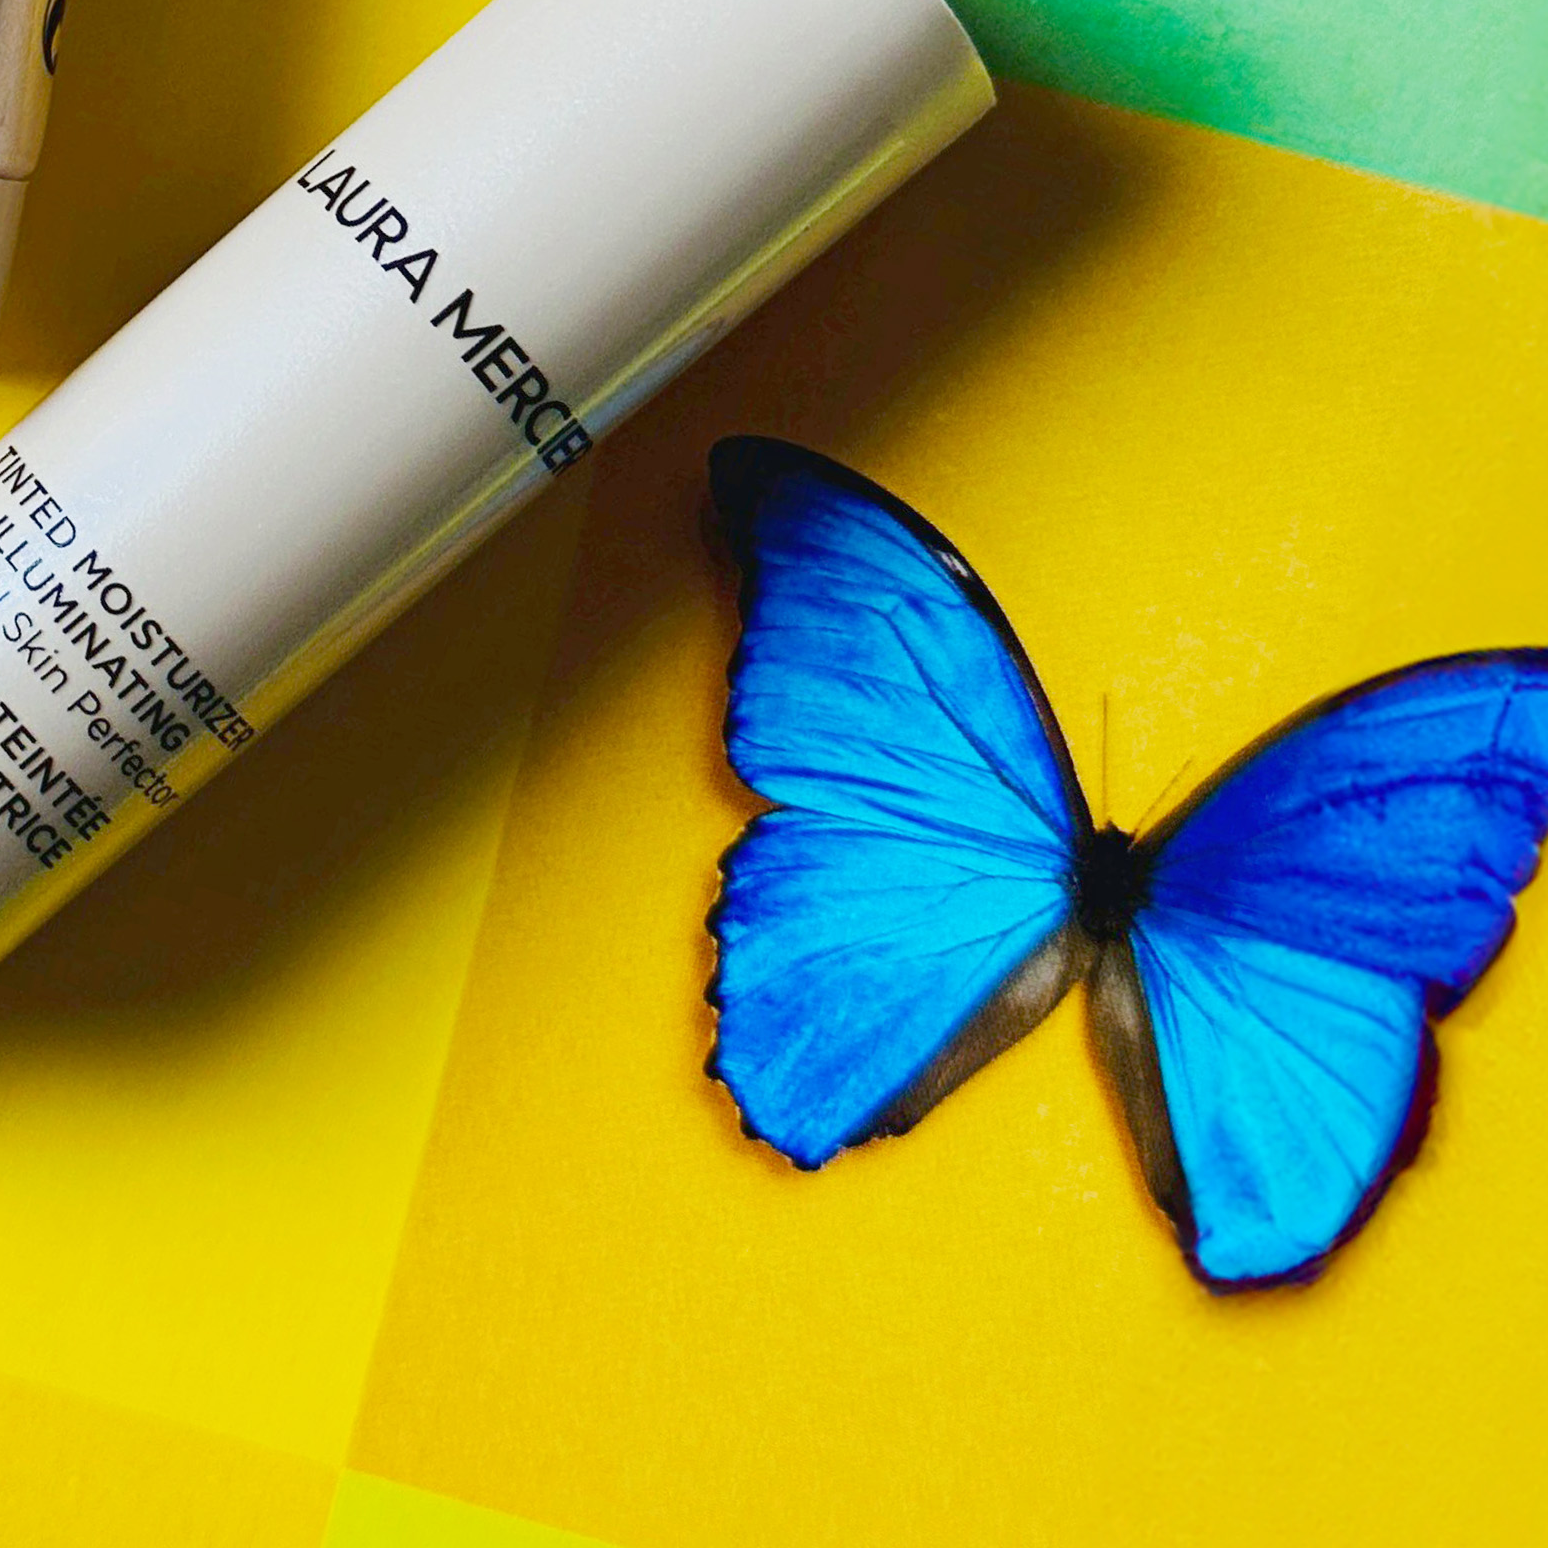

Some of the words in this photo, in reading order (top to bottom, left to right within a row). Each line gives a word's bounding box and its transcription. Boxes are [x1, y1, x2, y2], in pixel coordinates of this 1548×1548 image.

[297, 149, 439, 304] LAURA
[2, 611, 69, 694] Skin
[67, 689, 180, 808] Perfector
[72, 548, 255, 751] MOISTURIZER
